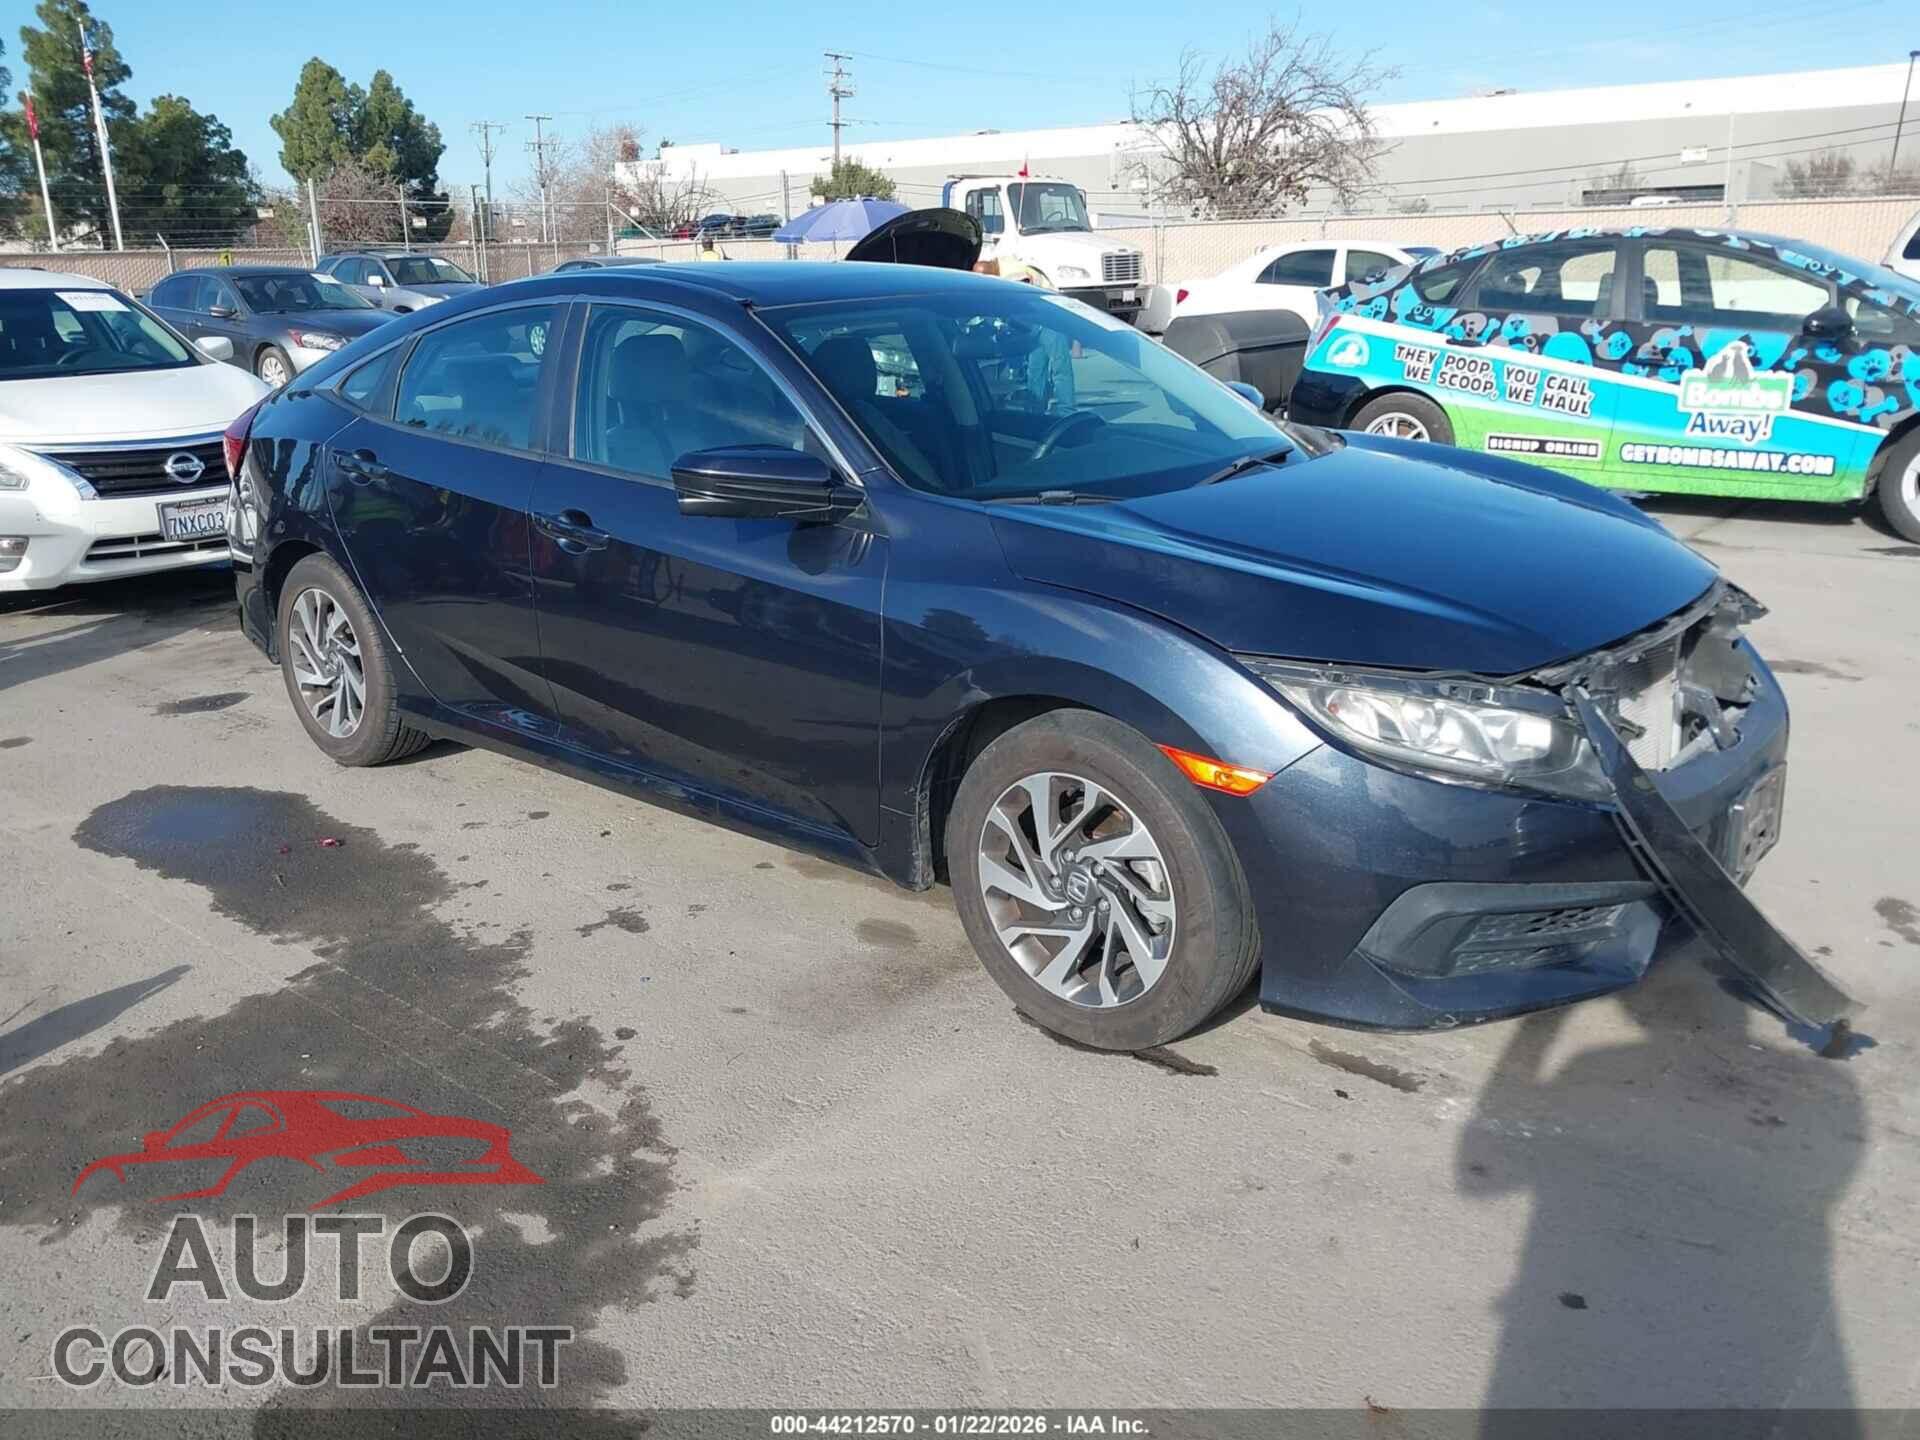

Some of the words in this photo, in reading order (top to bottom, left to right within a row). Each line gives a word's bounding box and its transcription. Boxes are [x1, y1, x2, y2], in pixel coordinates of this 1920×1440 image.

[1397, 346, 1437, 364] THEY
[1505, 367, 1537, 386] YOU
[1405, 365, 1431, 381] WE
[1438, 372, 1497, 399] SCOOP,
[1507, 387, 1534, 403] WE
[1542, 394, 1589, 415] HAUL
[1686, 381, 1784, 408] Bombs
[1689, 412, 1770, 441] Away!
[1621, 443, 1835, 475] GETBOMBSAWAY.COM
